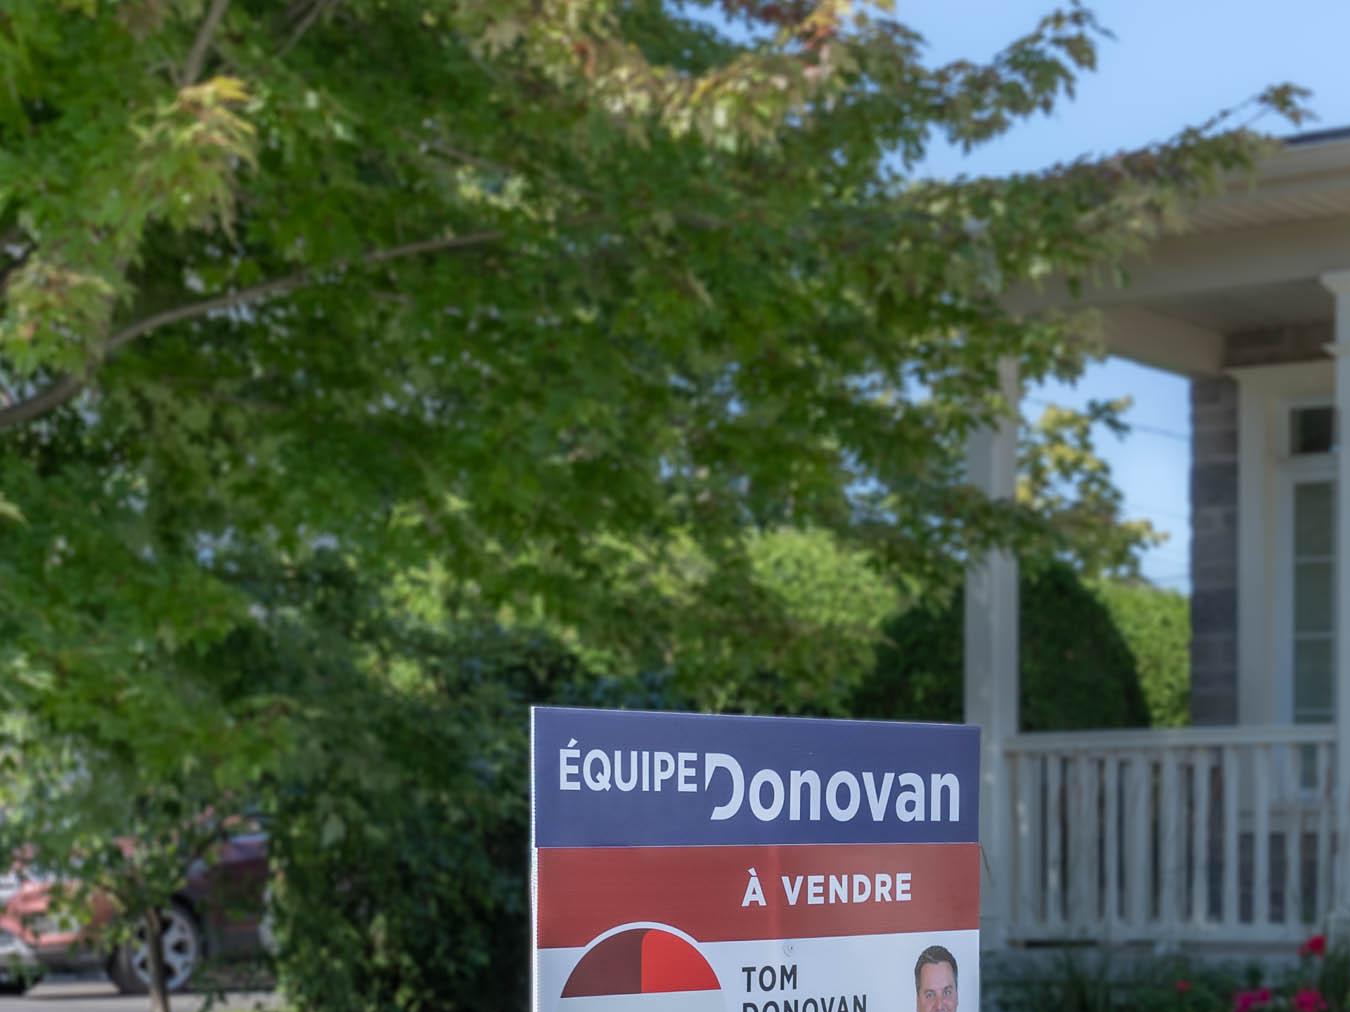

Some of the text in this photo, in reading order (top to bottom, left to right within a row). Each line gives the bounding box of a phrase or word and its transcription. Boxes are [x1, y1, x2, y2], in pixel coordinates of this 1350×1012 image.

[559, 738, 960, 823] ÉQUIPE Donovan
[741, 867, 912, 908] À VENDRE
[742, 964, 798, 993] TOM
